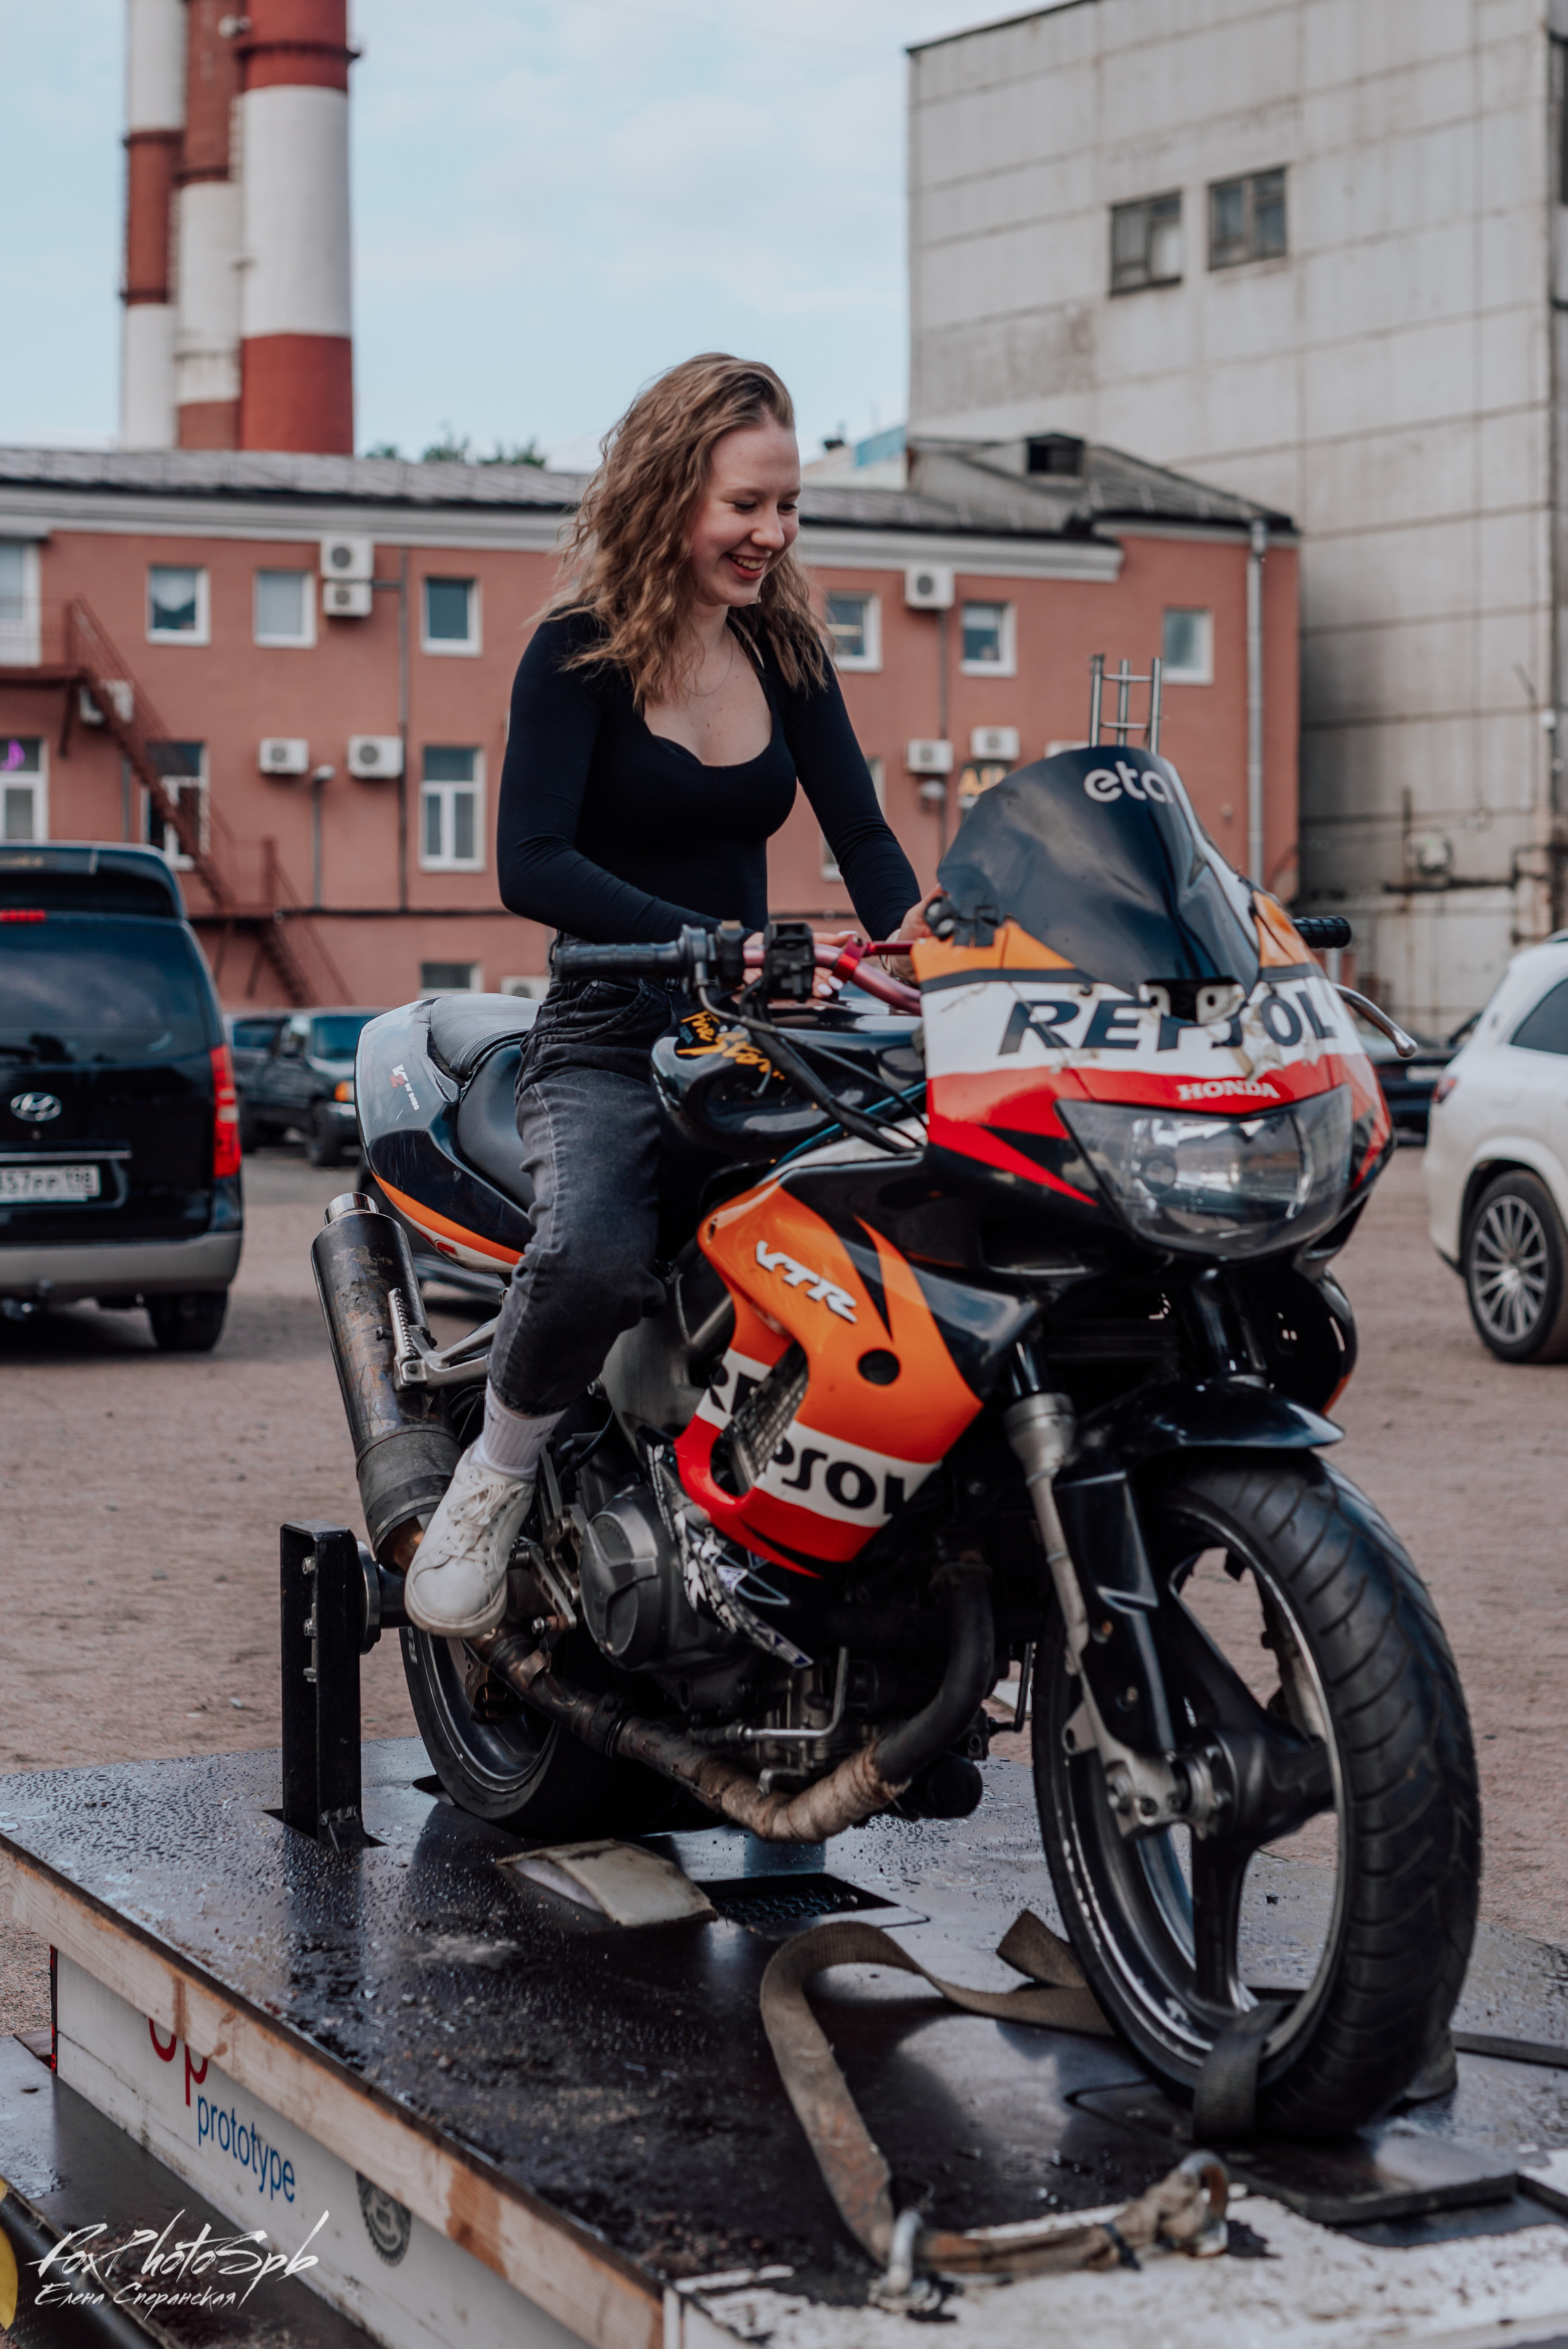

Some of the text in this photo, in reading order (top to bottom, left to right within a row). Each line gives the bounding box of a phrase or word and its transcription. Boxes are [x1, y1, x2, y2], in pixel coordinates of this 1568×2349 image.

[1084, 760, 1175, 805] eta
[1177, 1080, 1280, 1101] HONDA
[756, 1240, 858, 1323] VTR
[198, 2094, 295, 2203] prototype
